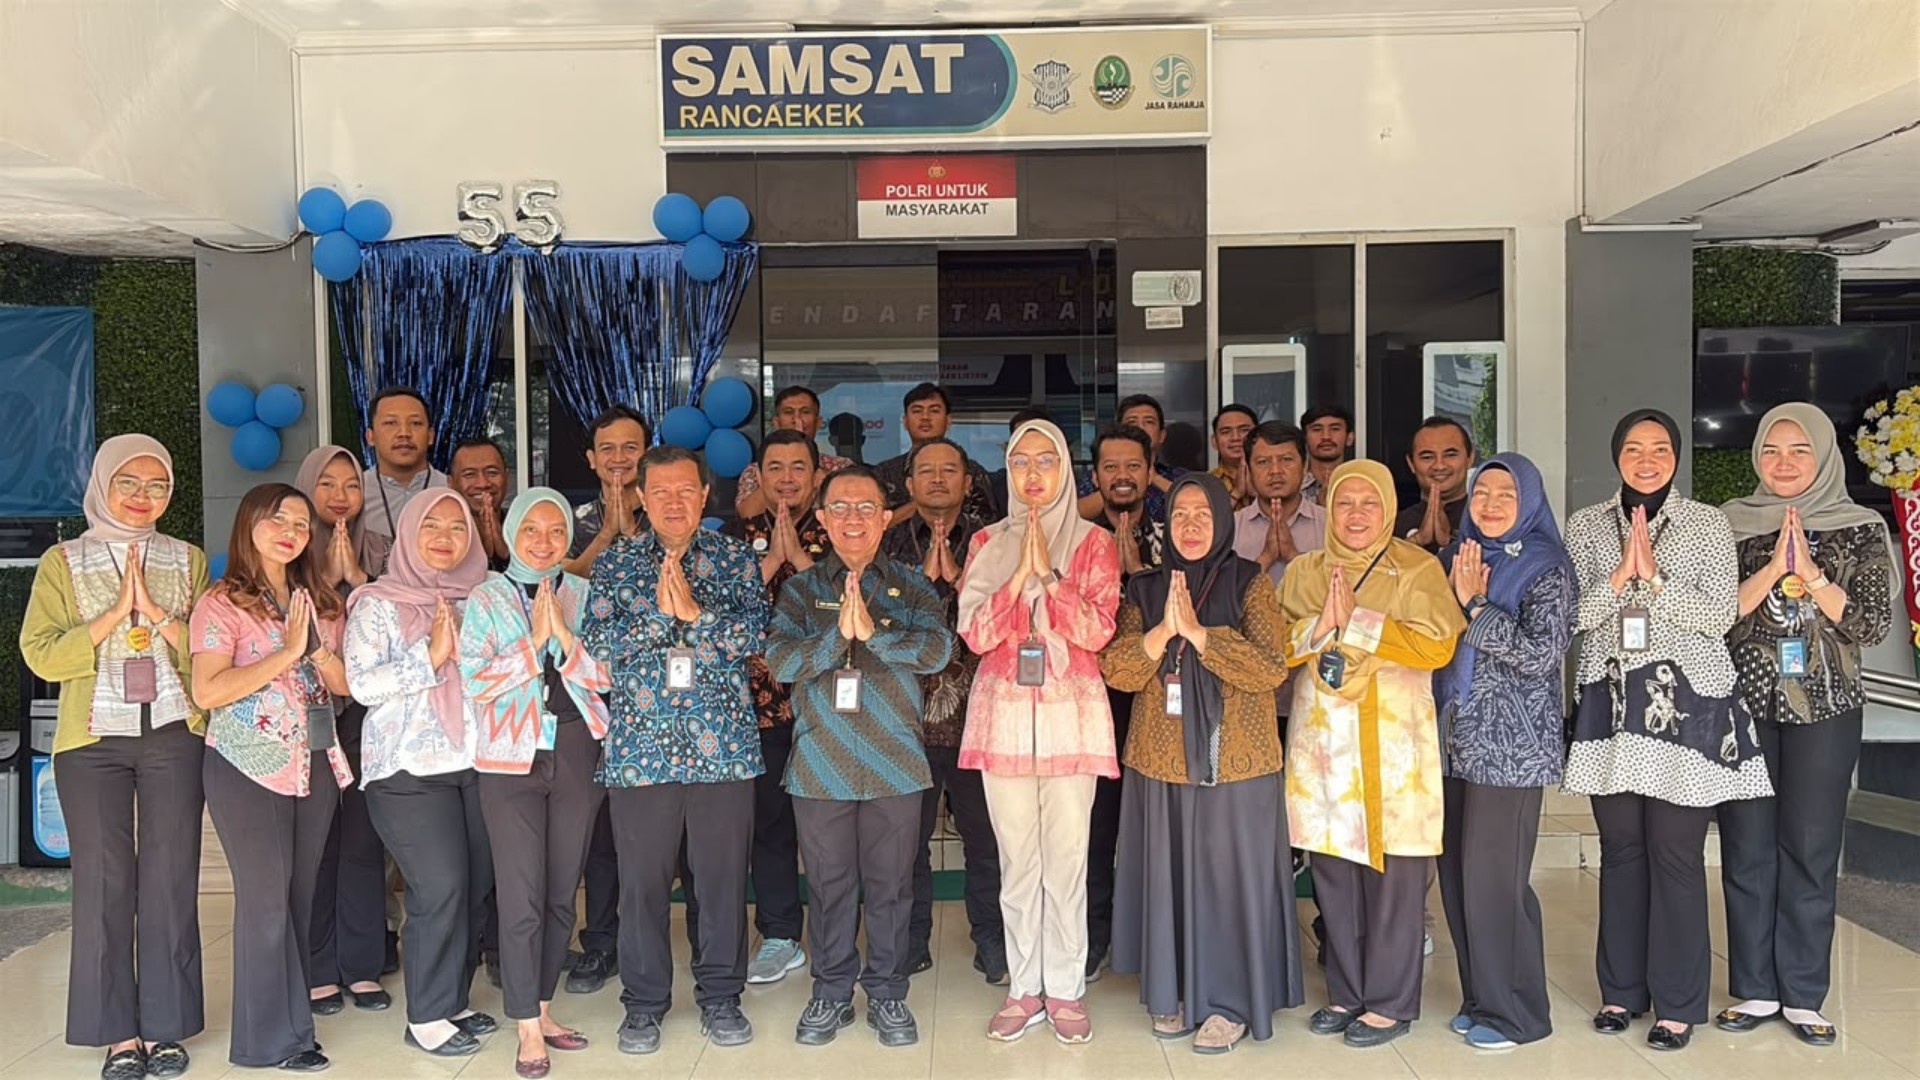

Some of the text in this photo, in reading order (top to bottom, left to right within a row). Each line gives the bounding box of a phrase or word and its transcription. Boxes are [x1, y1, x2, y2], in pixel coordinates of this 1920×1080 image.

[671, 43, 965, 97] SAMSAT
[679, 102, 864, 129] RANCAEKEK
[1144, 100, 1205, 110] JASA RAHARJA
[885, 182, 989, 198] POLRI UNTUK
[456, 180, 565, 250] 55
[885, 202, 989, 217] MASYARAKAT
